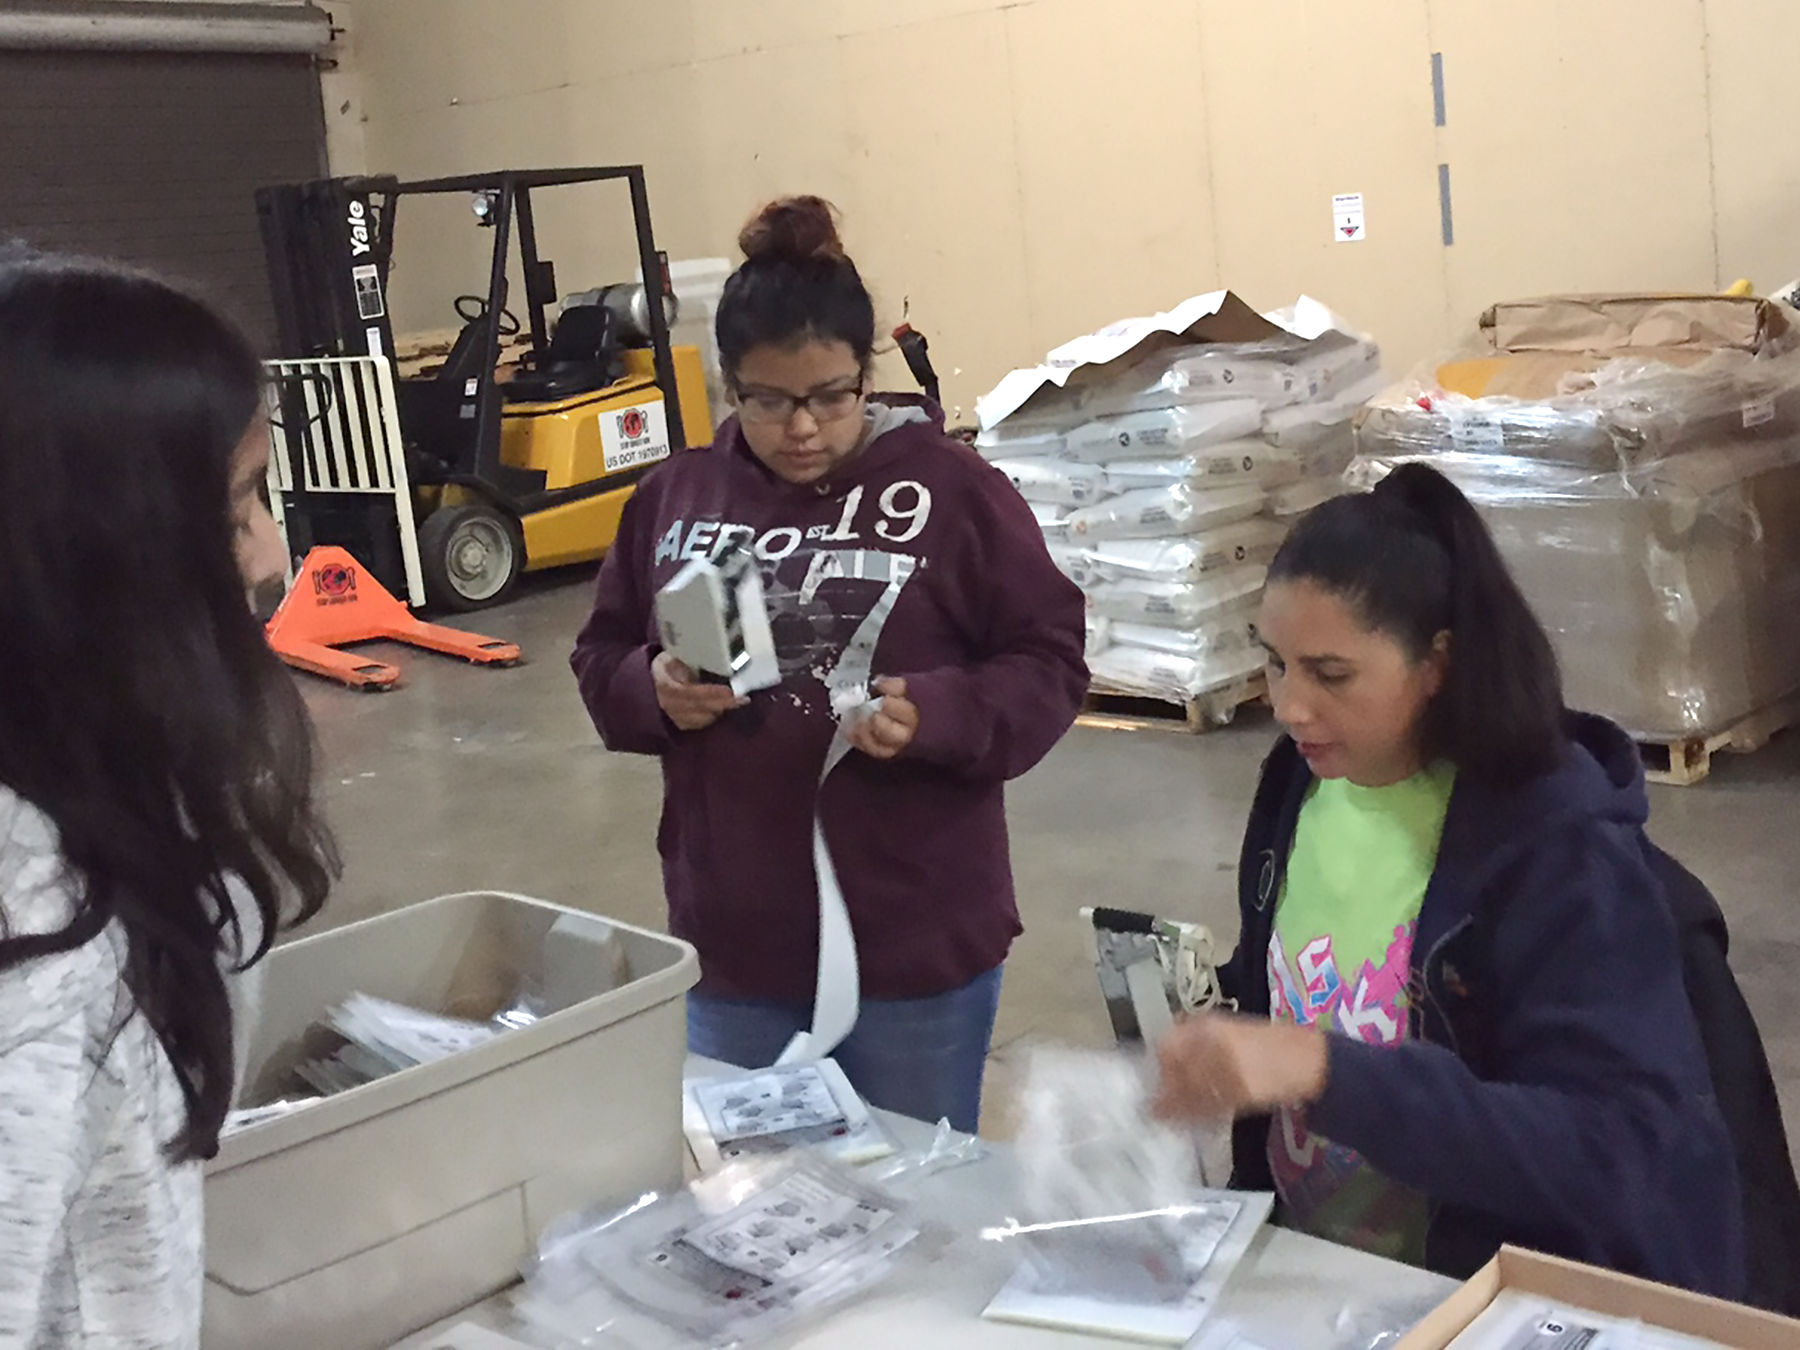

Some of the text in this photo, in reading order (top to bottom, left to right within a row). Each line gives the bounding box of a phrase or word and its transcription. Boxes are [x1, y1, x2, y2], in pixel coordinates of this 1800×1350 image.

[347, 200, 370, 257] Yale
[606, 456, 618, 468] US
[619, 452, 635, 465] DOT
[655, 519, 802, 566] AERO
[820, 478, 932, 542] 19
